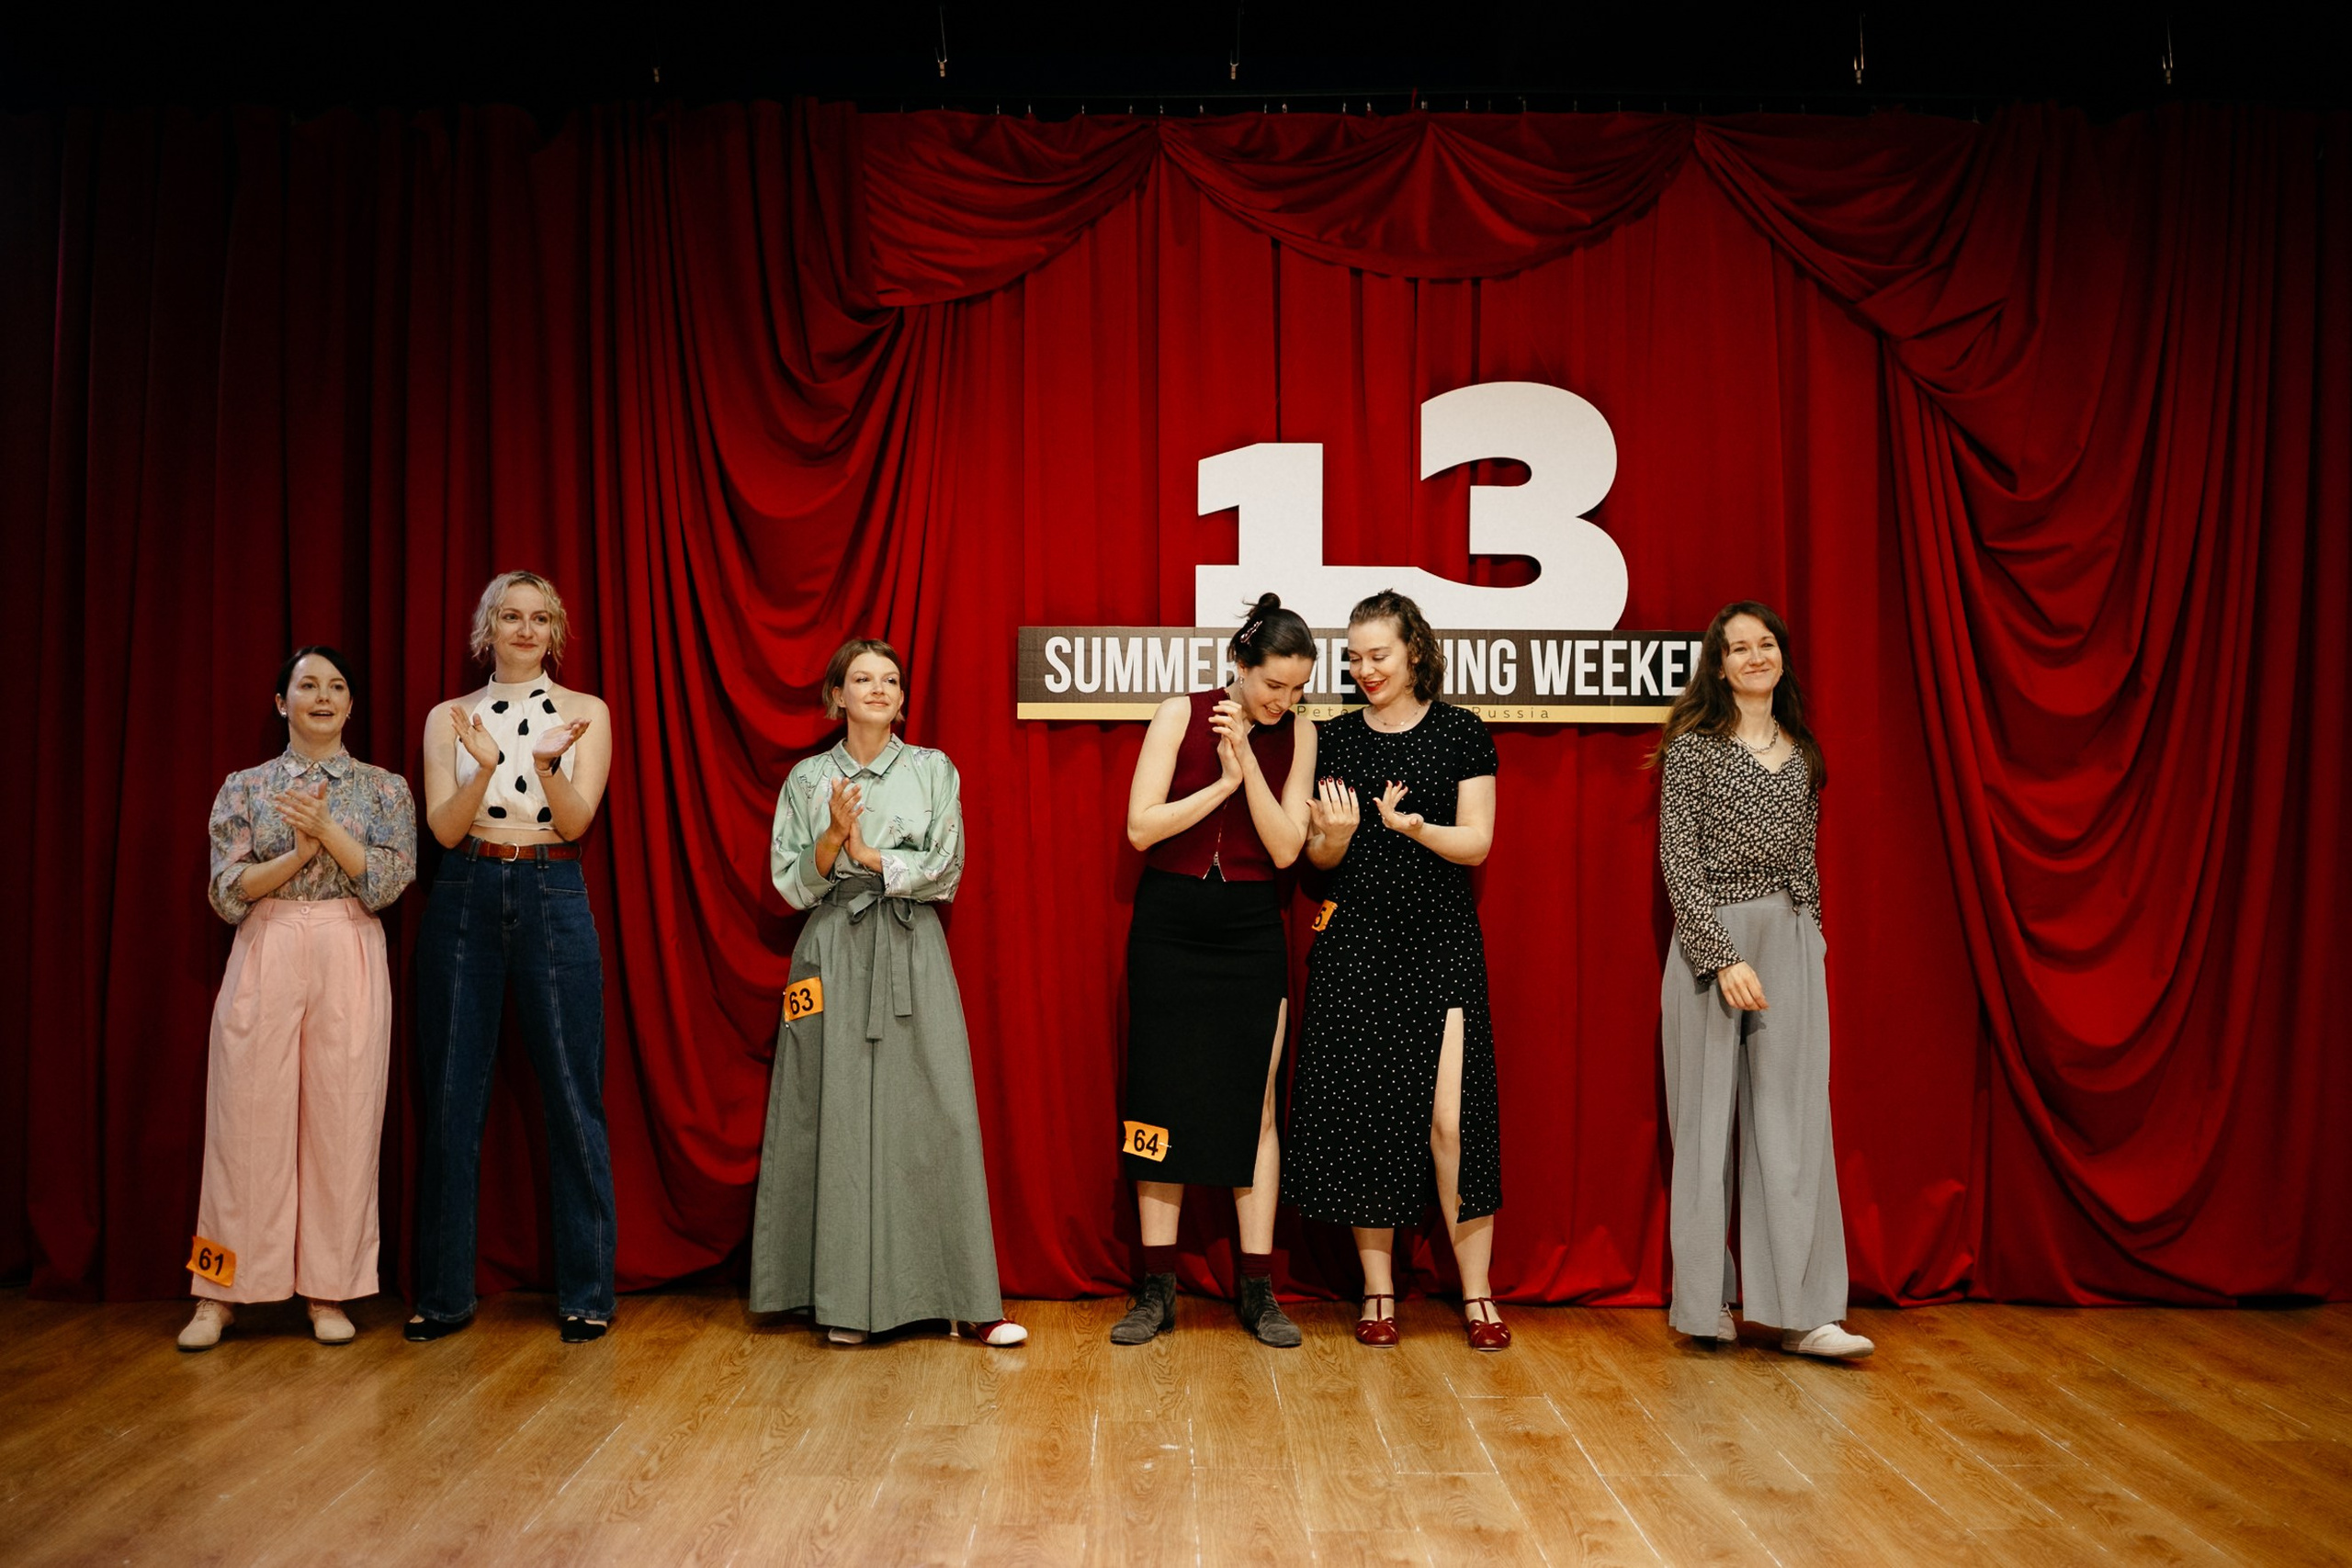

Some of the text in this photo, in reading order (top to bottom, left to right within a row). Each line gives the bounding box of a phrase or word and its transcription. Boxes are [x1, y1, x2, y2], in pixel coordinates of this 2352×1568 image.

[1195, 381, 1629, 630] 13
[1435, 638, 1518, 695] ING
[1471, 706, 1550, 719] Russia
[789, 987, 814, 1015] 63
[1134, 1128, 1159, 1156] 64
[198, 1247, 224, 1276] 61
